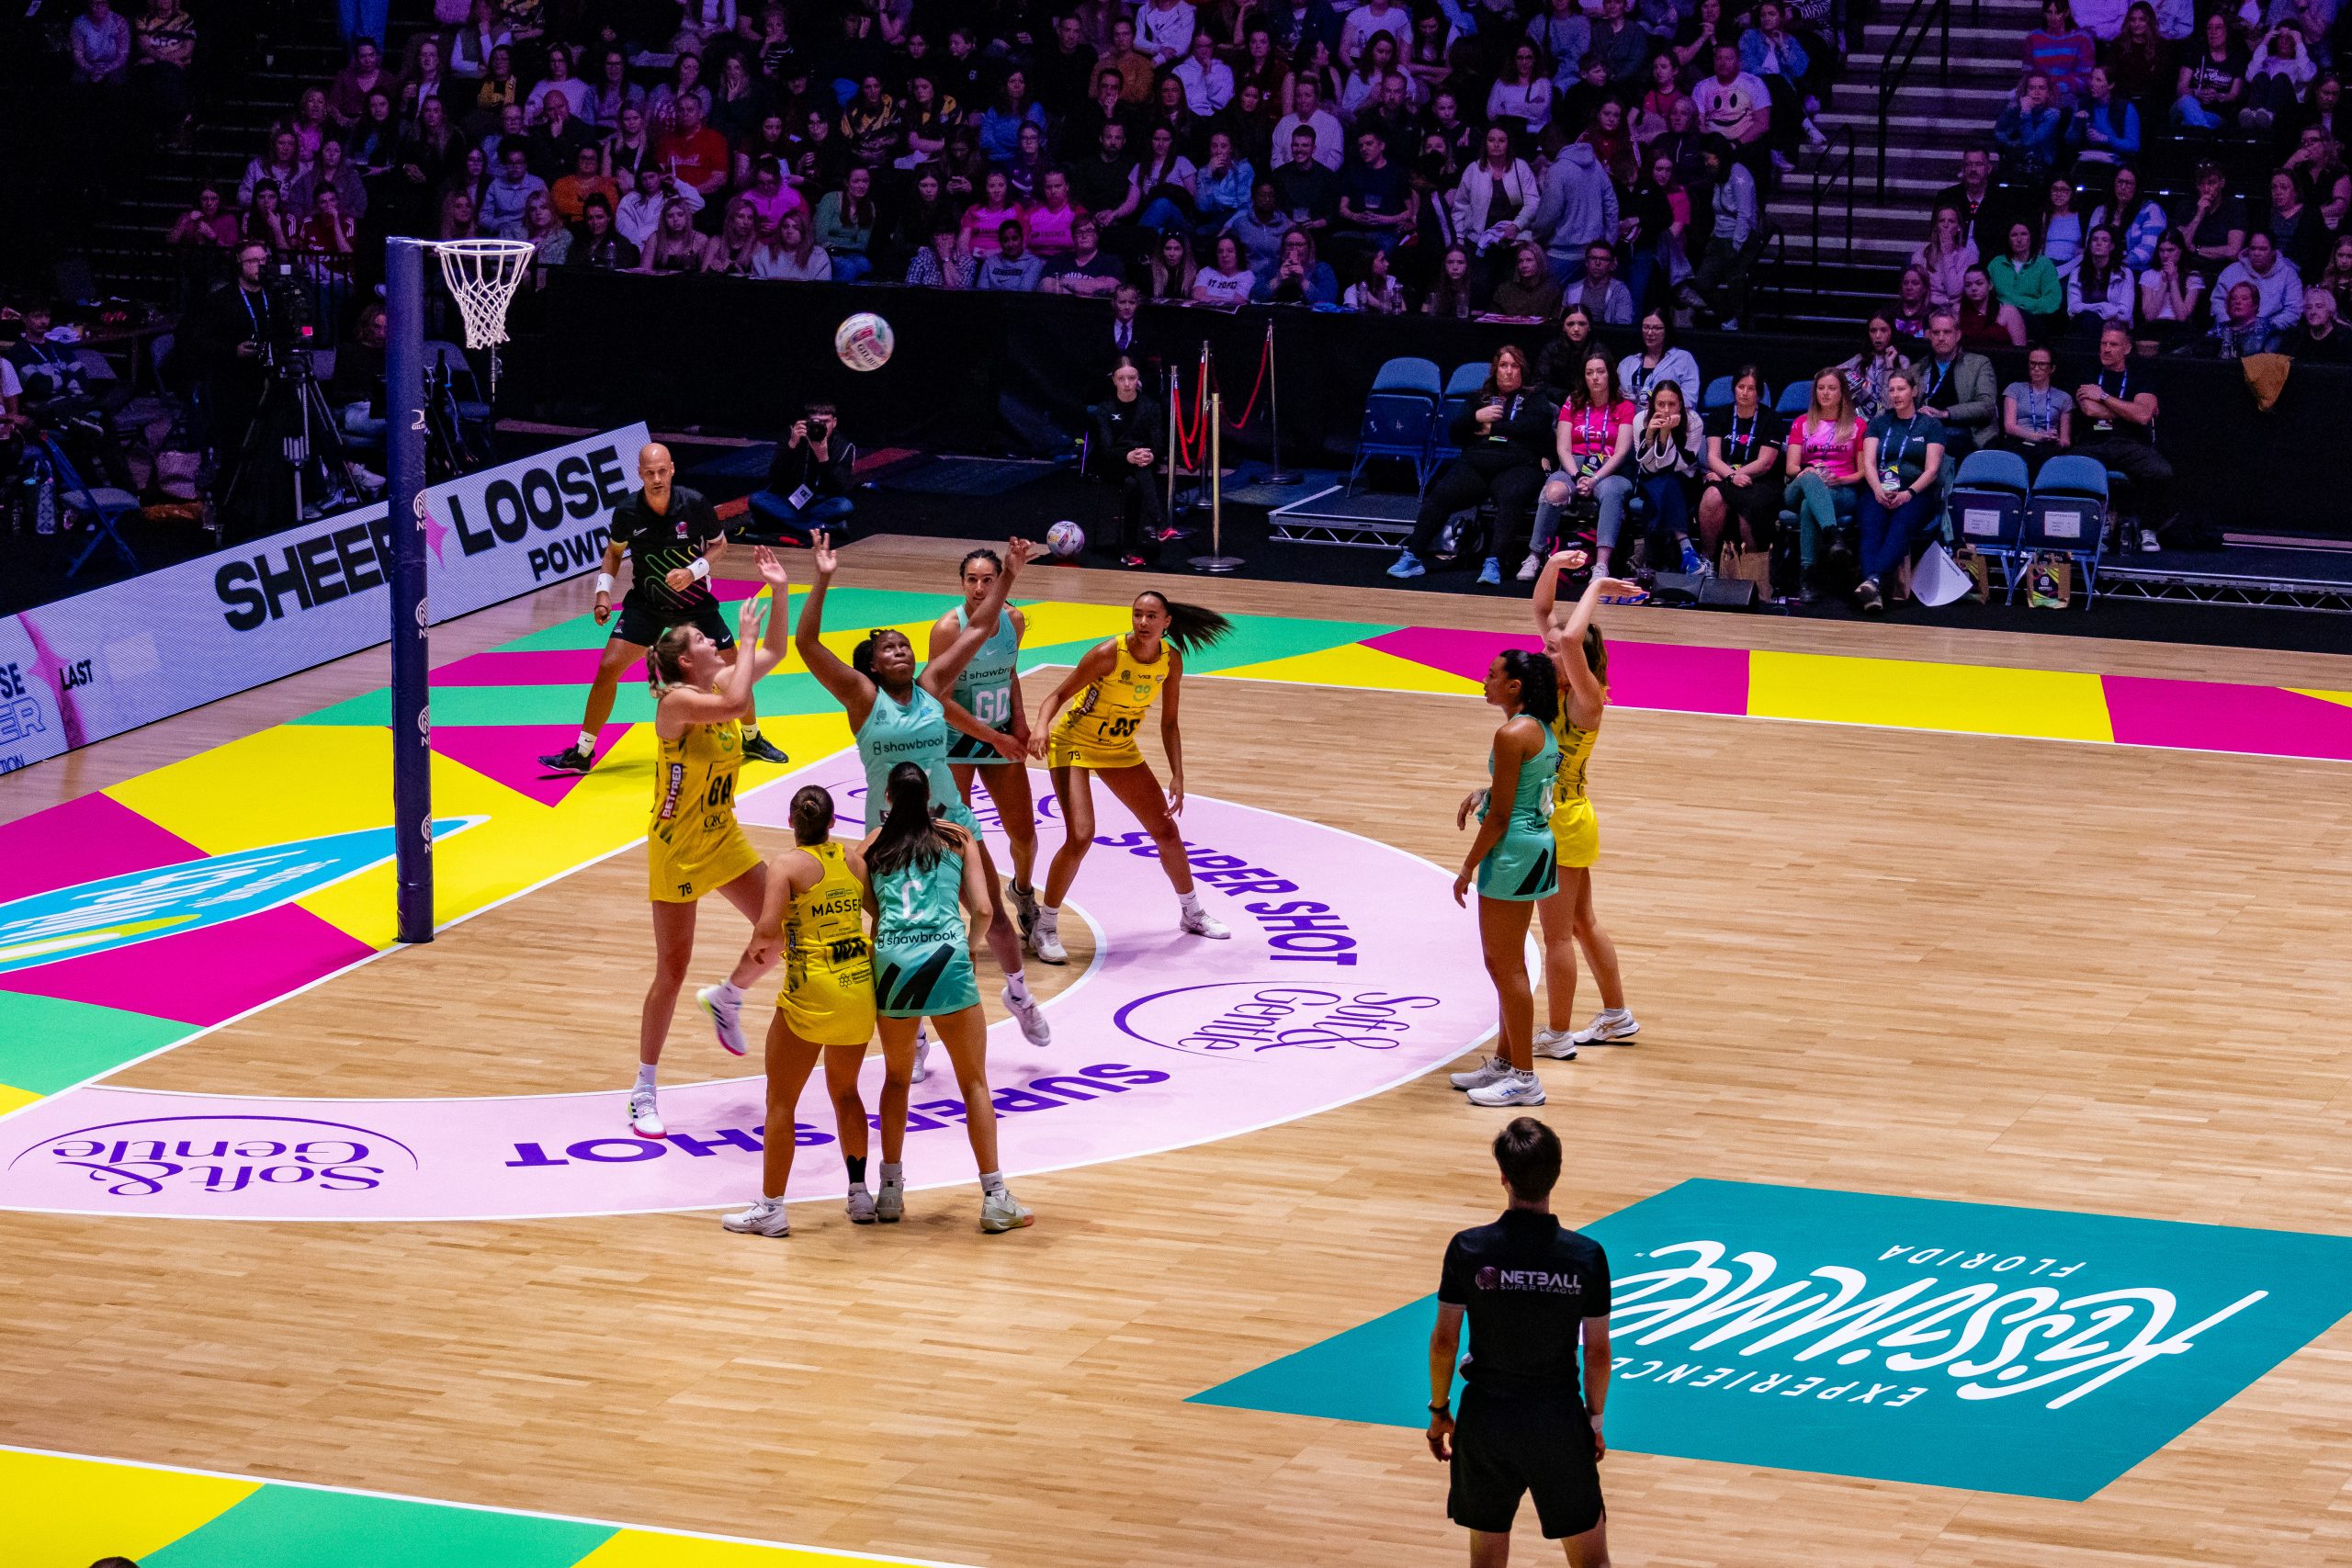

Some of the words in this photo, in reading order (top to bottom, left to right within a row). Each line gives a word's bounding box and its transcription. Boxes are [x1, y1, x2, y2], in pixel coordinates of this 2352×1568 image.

[447, 445, 629, 557] LOOSE
[527, 526, 611, 582] POWD
[214, 516, 390, 632] SHEE
[59, 659, 93, 690] LAST
[976, 687, 1011, 726] GD
[1068, 750, 1081, 761] 79
[662, 764, 683, 818] BETFRED
[707, 771, 733, 807] GA
[678, 882, 693, 897] 78
[901, 879, 924, 920] C
[1092, 831, 1299, 897] SUPER
[1244, 901, 1357, 965] SHOT
[887, 931, 958, 946] shawbrook
[1177, 988, 1341, 1050] Gentle
[1312, 992, 1441, 1032] Soft
[1254, 1028, 1400, 1053] &
[52, 1140, 369, 1164] Gentle
[506, 1122, 836, 1168] SHOT
[55, 1161, 184, 1195] &
[188, 1166, 384, 1191] Soft
[1500, 1269, 1582, 1288] NETBALL
[1878, 1244, 2088, 1280] FLORIDA
[1540, 1286, 1581, 1295] LEAGUE
